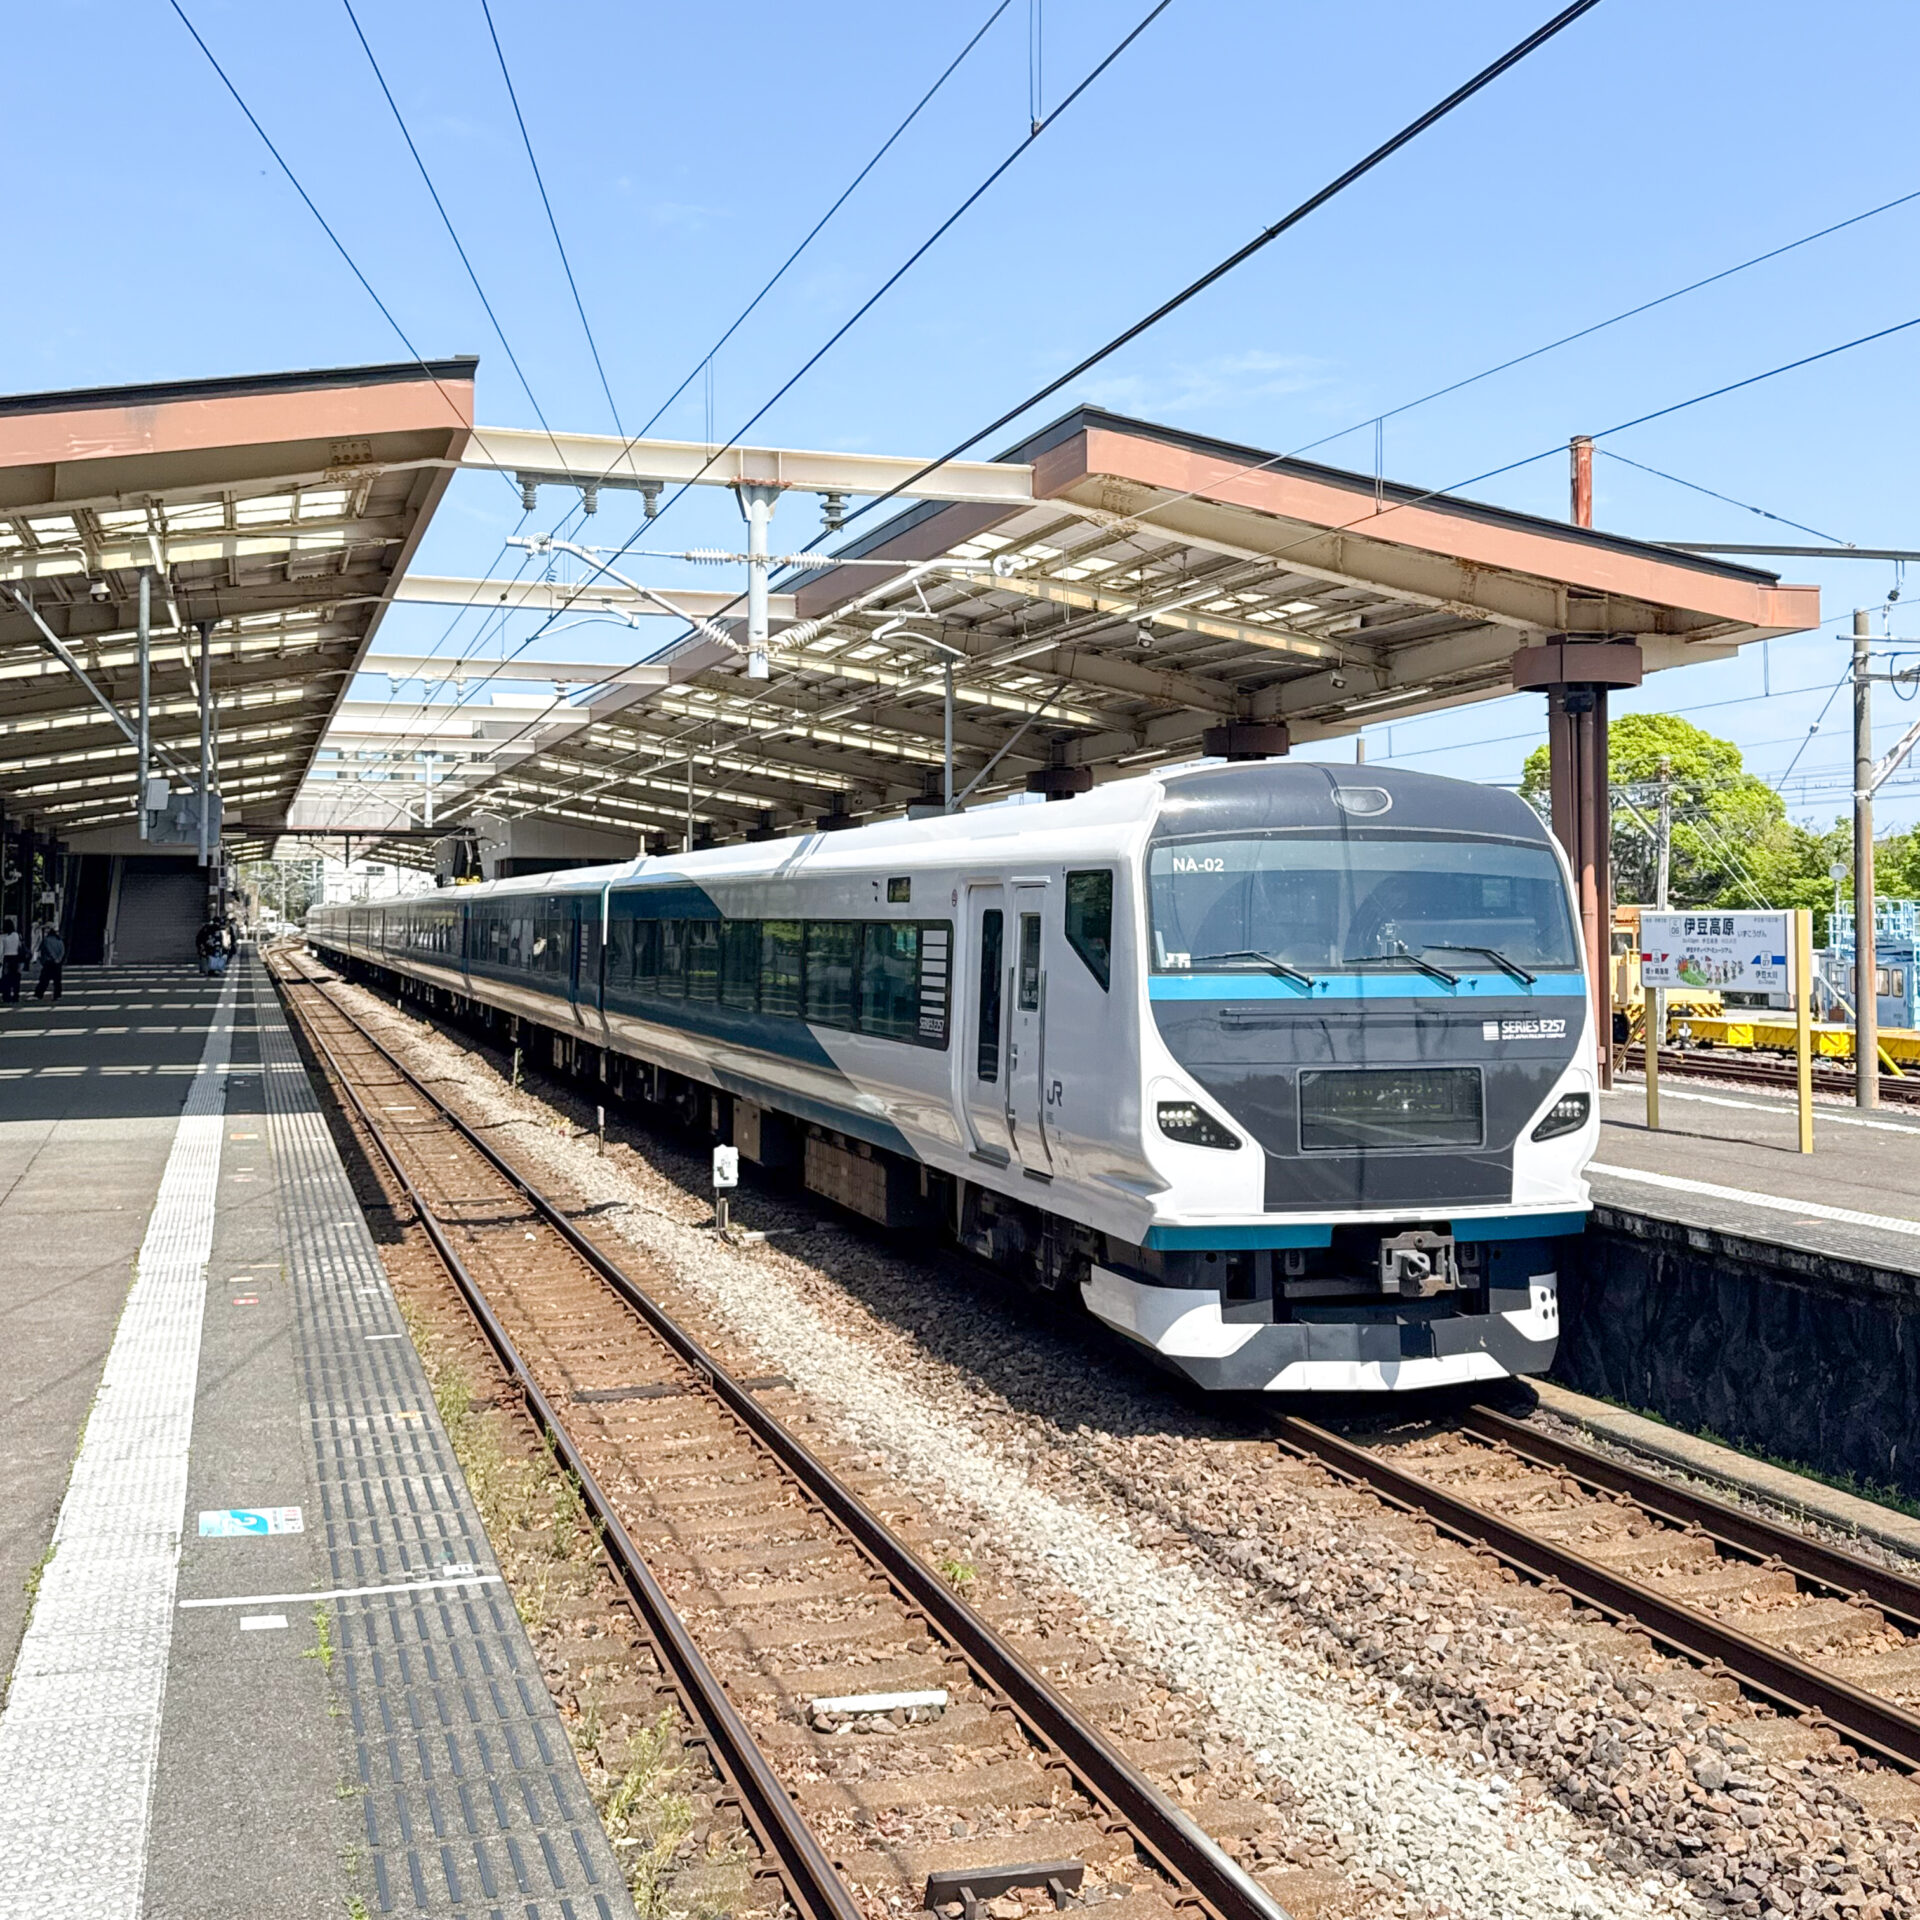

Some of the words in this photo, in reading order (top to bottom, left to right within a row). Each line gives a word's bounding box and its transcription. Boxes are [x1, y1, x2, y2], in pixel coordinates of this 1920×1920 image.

[1173, 857, 1225, 872] NA-02
[1684, 917, 1735, 936] 伊豆高原
[1762, 959, 1770, 967] 07
[1502, 1020, 1539, 1033] SERIES
[1540, 1019, 1566, 1032] E257
[1046, 1080, 1063, 1107] JR
